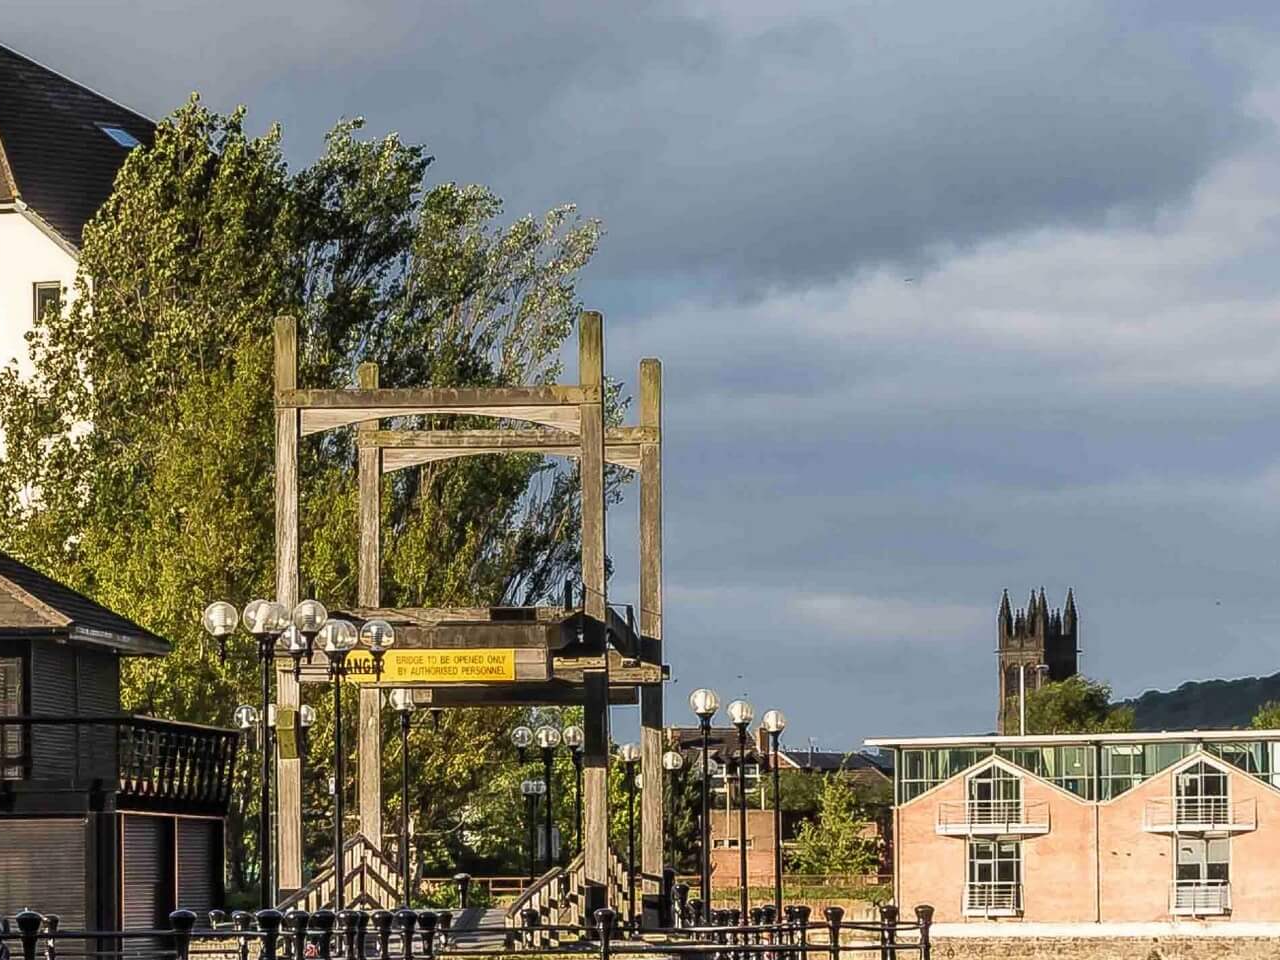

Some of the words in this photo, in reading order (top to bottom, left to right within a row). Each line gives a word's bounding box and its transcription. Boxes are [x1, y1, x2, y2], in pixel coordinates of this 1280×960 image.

[395, 655, 425, 665] BRIDGE
[427, 655, 437, 665] TO
[440, 655, 450, 665] BE
[453, 655, 484, 665] OPENED
[487, 655, 507, 665] ONLY
[397, 666, 408, 676] BY
[410, 666, 458, 676] AUTHORISED
[461, 665, 507, 675] PERSONNEL
